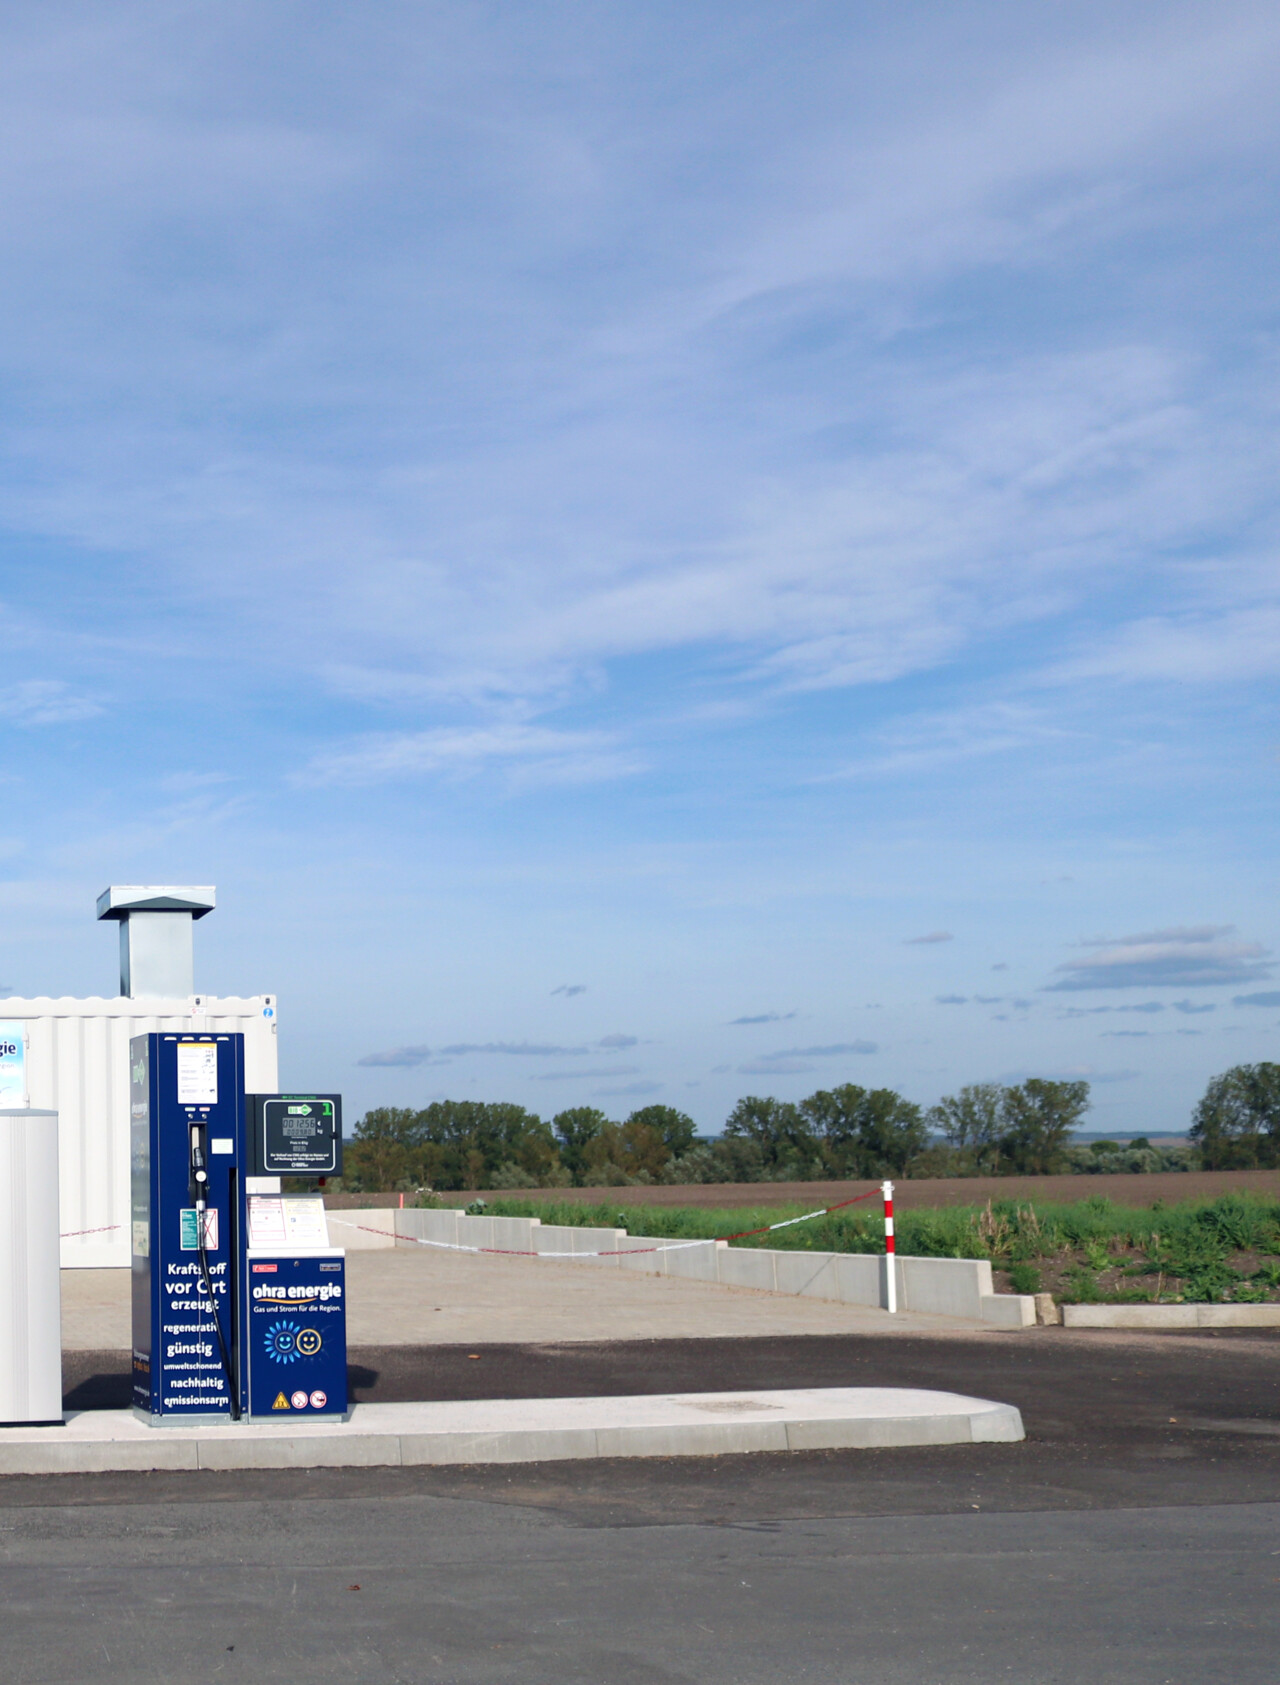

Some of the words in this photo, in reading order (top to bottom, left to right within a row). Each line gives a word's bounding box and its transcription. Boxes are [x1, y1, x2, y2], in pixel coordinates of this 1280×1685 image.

[322, 1103, 332, 1116] 1
[167, 1262, 228, 1275] Kraftsoff
[165, 1282, 193, 1294] vor
[252, 1283, 287, 1299] ohra
[287, 1282, 342, 1301] energie
[170, 1298, 220, 1313] erzeugt
[253, 1305, 265, 1313] Gas
[266, 1305, 278, 1313] und
[279, 1305, 298, 1313] Strom
[298, 1304, 308, 1312] für
[308, 1304, 318, 1312] die
[319, 1304, 342, 1313] Region.
[166, 1341, 213, 1357] günstig
[163, 1361, 223, 1370] umweltschonend
[170, 1376, 225, 1390] nachhaltig
[163, 1394, 229, 1408] emissionsarm
